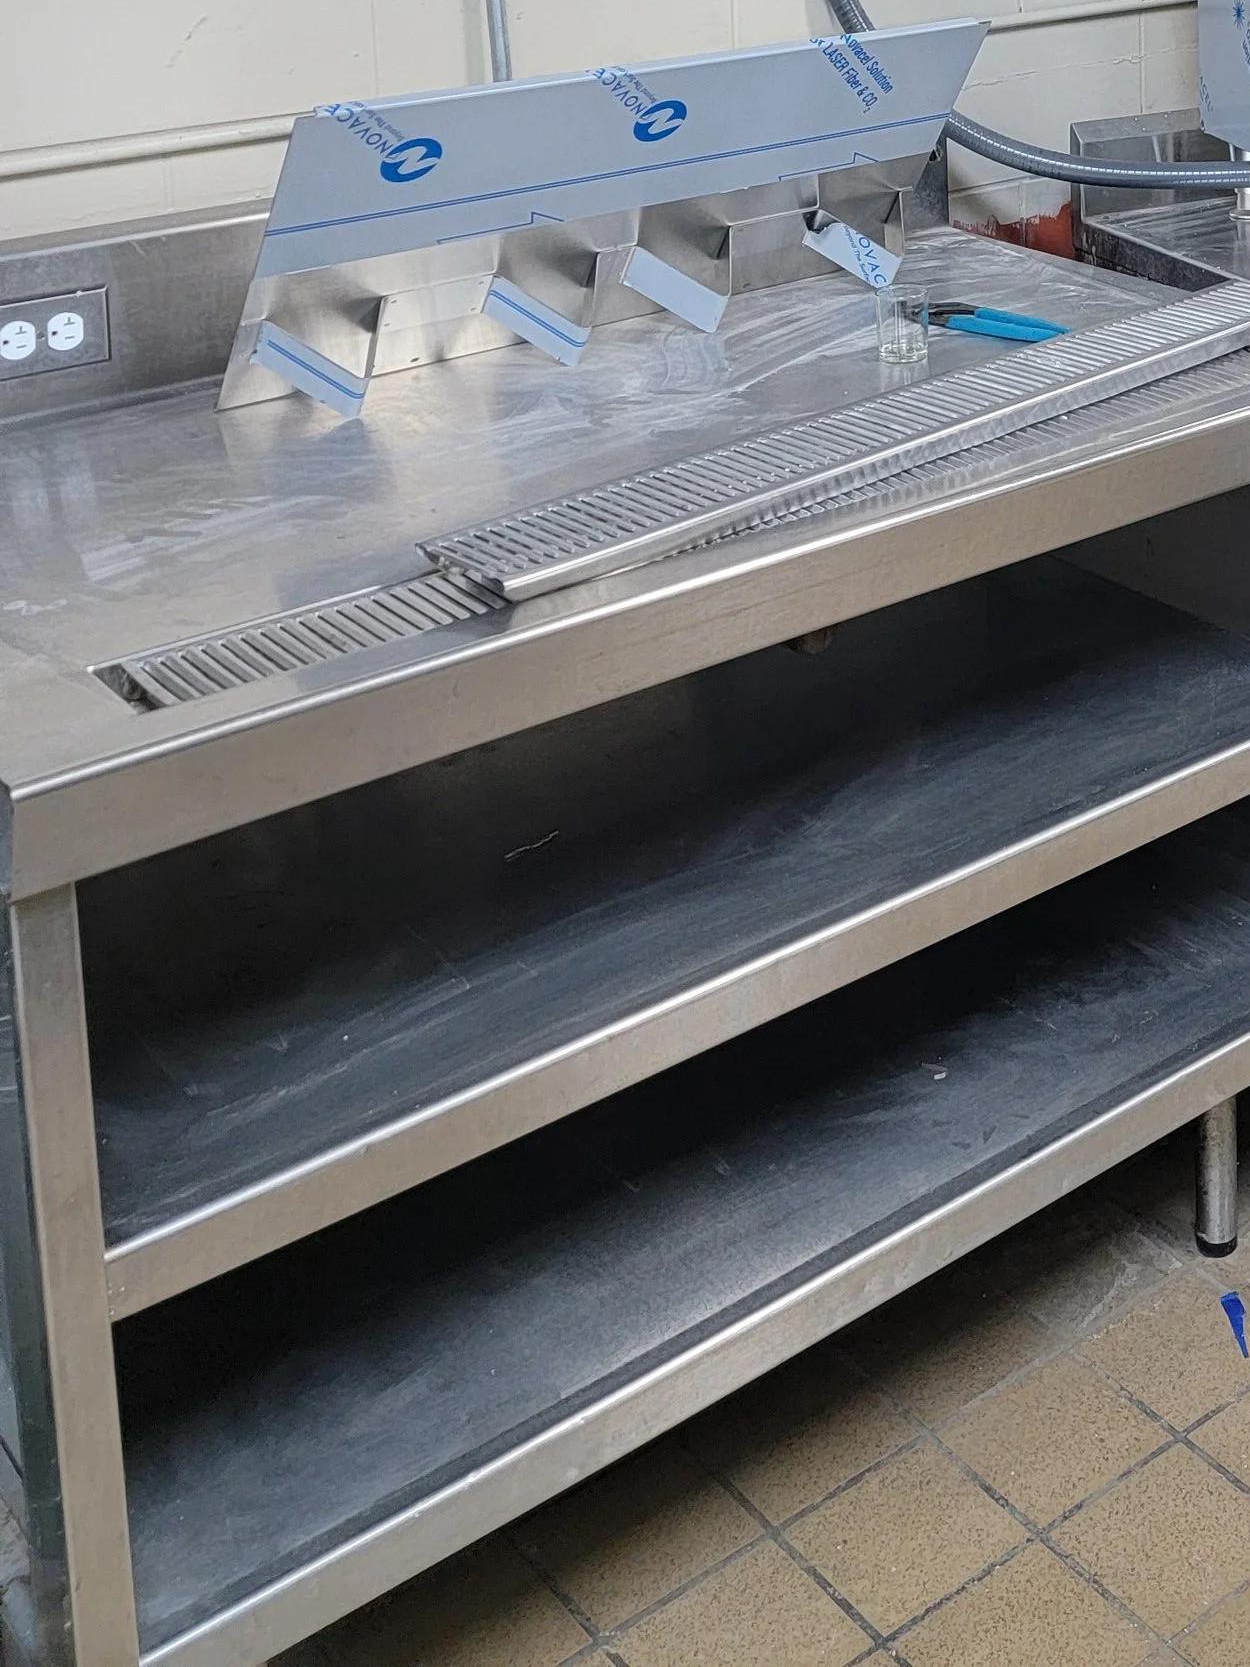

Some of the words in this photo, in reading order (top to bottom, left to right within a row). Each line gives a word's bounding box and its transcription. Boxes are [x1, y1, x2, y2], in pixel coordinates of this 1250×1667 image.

[822, 42, 850, 73] LASER
[841, 67, 863, 91] Fiber
[856, 85, 869, 97] &
[866, 61, 894, 94] Solution
